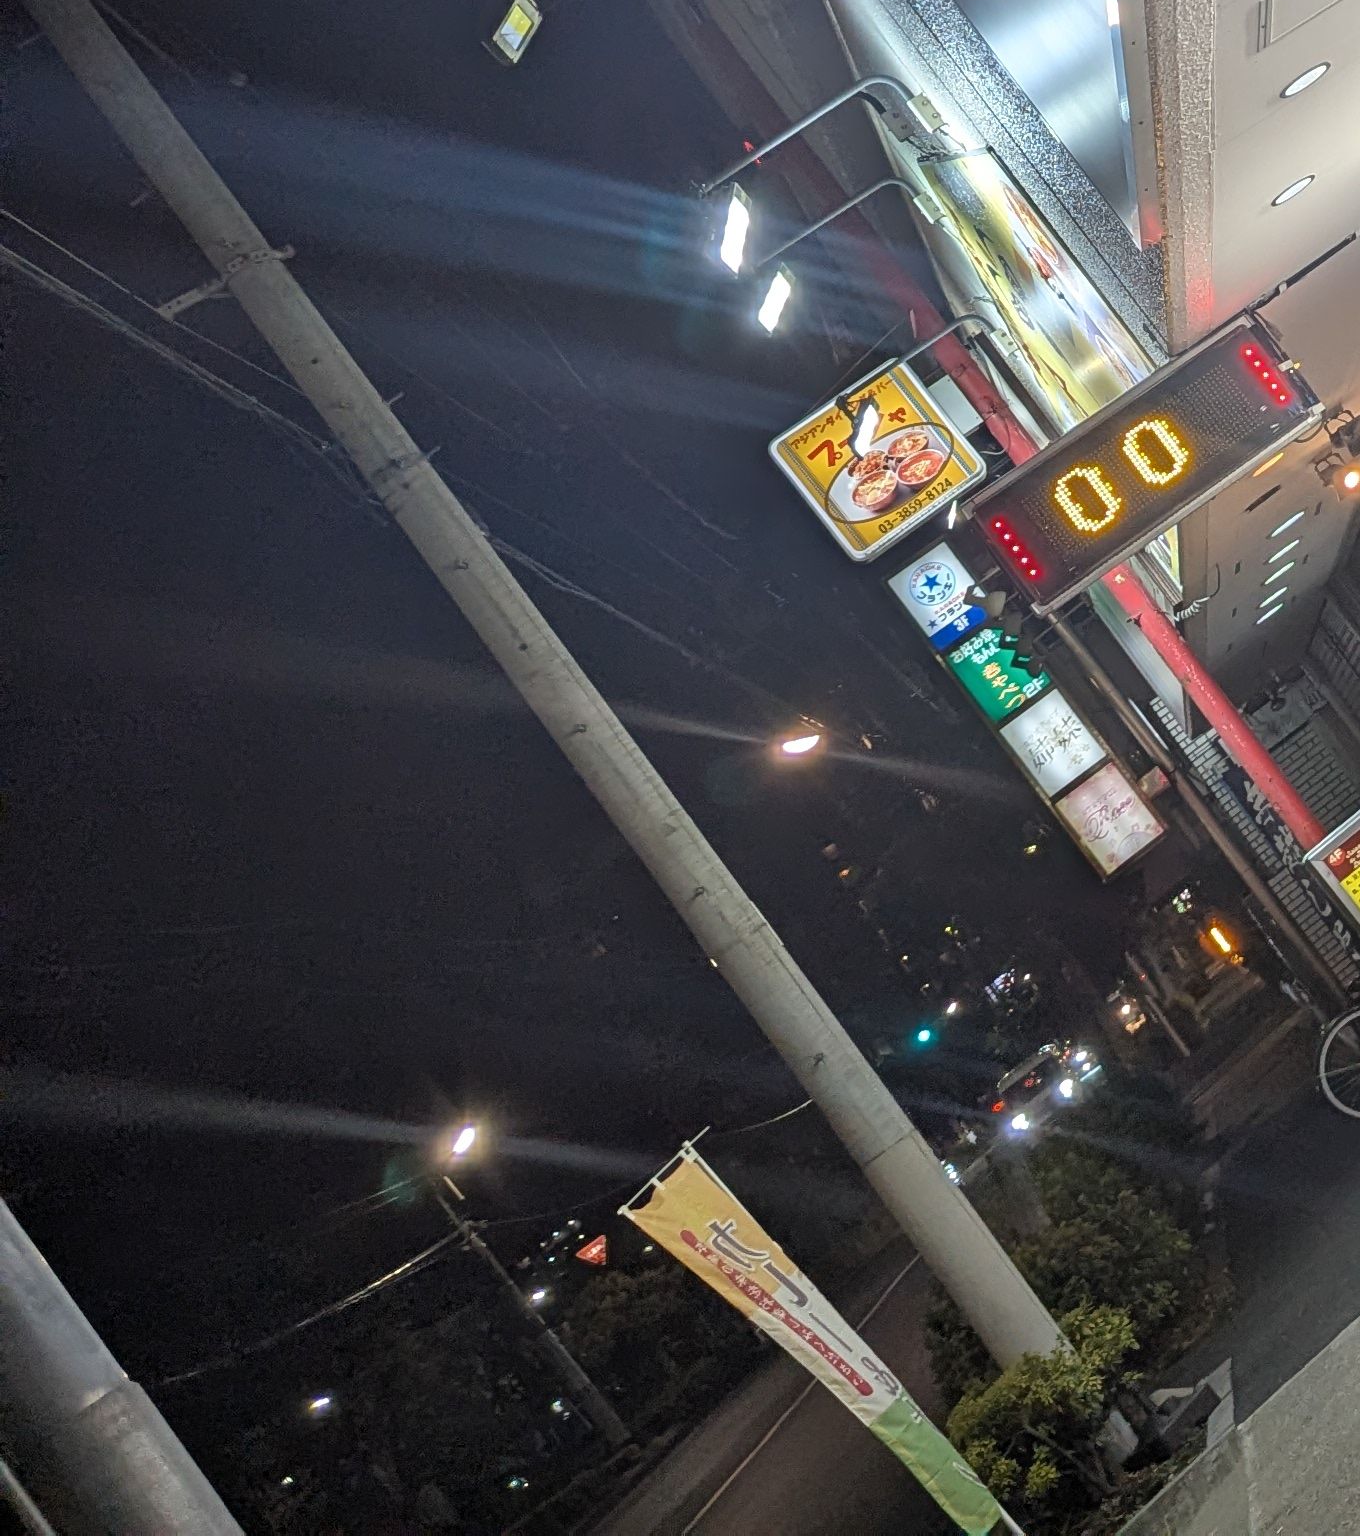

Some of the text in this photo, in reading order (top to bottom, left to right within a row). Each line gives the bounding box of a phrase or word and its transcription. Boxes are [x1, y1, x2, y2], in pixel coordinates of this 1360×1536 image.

[877, 476, 953, 535] 03-3859-8124
[952, 613, 971, 632] 3F
[948, 625, 995, 666] お好み焼
[1021, 673, 1047, 699] 2F
[1328, 848, 1344, 864] 4F
